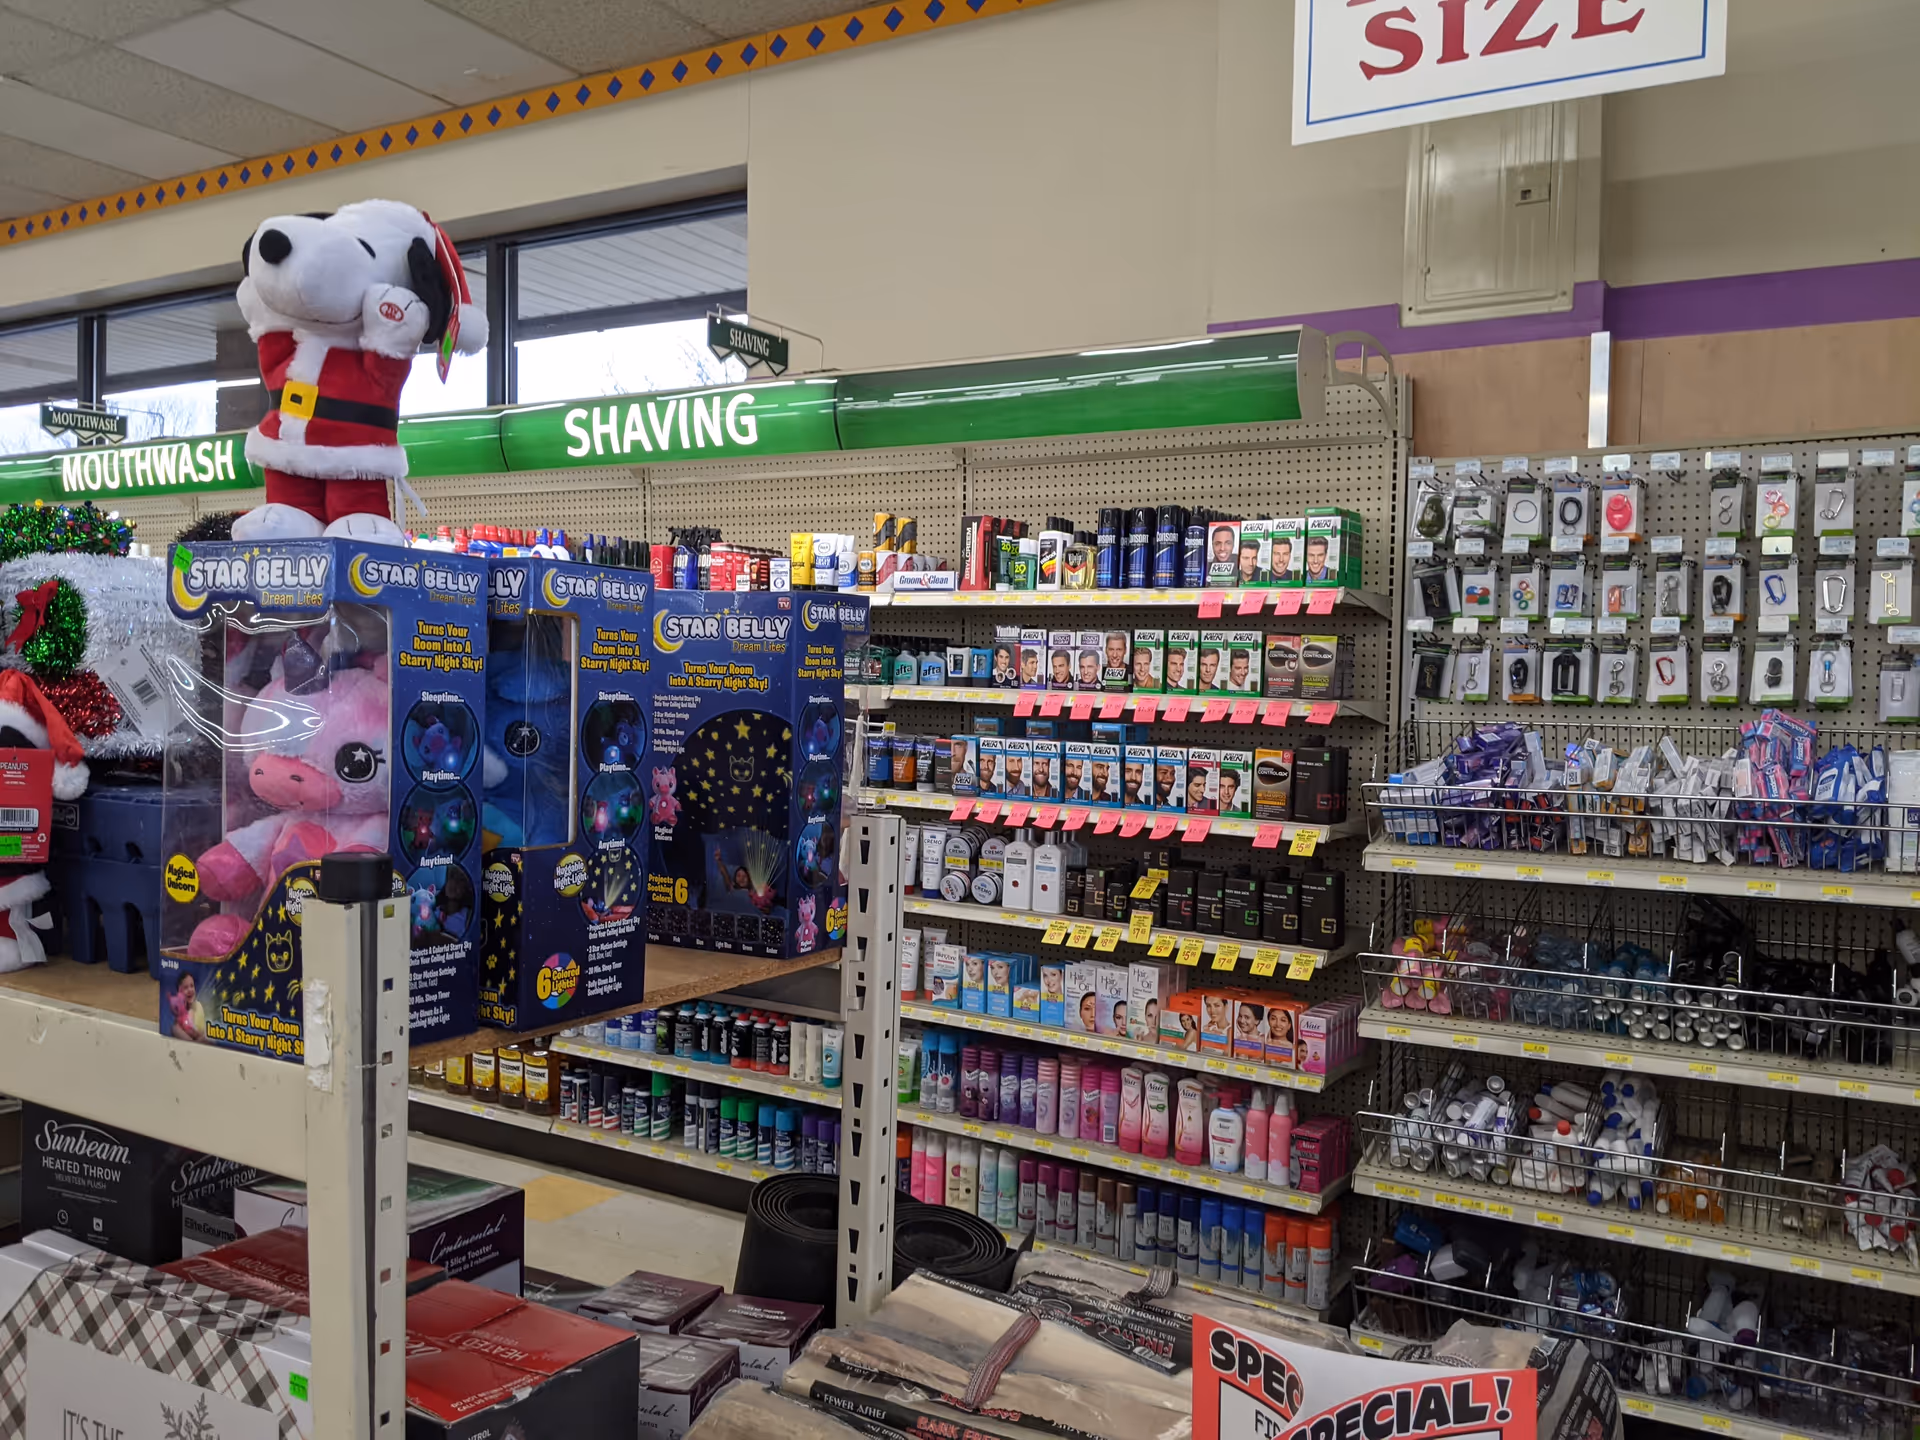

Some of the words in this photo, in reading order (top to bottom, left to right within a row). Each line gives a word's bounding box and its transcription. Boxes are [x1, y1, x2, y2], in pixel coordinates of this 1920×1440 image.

[1358, 0, 1645, 81] SIZE
[730, 327, 770, 357] SHAVING
[52, 410, 117, 432] MOUTHWASH
[564, 393, 758, 458] SHAVING
[62, 440, 236, 492] MOUTHWASH
[1156, 531, 1179, 543] CONSORT
[963, 527, 972, 580] BRYLCREEM
[189, 557, 249, 591] STAR
[253, 556, 329, 589] BELLY
[1014, 563, 1026, 574] 29
[365, 560, 418, 588] STAR
[423, 567, 480, 594] BELLY
[555, 575, 598, 598] STAR
[601, 581, 647, 602] BELLY
[261, 591, 294, 605] Dream
[297, 591, 323, 605] Lites
[495, 600, 520, 615] Lites
[809, 604, 836, 622] STAR
[839, 607, 866, 622] BELLY
[417, 621, 445, 636] Turns
[446, 623, 468, 638] Your
[597, 627, 618, 641] Turns
[620, 629, 638, 642] Your
[666, 616, 720, 639] STAR
[725, 616, 791, 640] BELLY
[413, 637, 441, 652] Room
[443, 638, 463, 653] Into
[465, 641, 471, 654] A
[593, 642, 615, 655] Room
[617, 645, 633, 656] Into
[634, 646, 640, 657] A
[732, 641, 761, 653] Dream
[763, 641, 786, 653] Lites
[807, 645, 822, 654] Turns
[822, 645, 835, 654] Your
[400, 652, 432, 670] Starry
[434, 655, 460, 673] Night
[461, 656, 483, 673] Sky!
[581, 656, 608, 673] Starry
[609, 659, 631, 673] Night
[632, 660, 650, 674] Sky!
[684, 662, 707, 674] Turns
[708, 662, 727, 675] Your
[729, 663, 753, 675] Room
[805, 656, 821, 666] Room
[820, 657, 832, 666] Into
[798, 668, 816, 680] Starry
[816, 668, 830, 681] Night
[831, 669, 842, 680] Sky!
[896, 664, 912, 676] afta
[922, 664, 942, 677] afta
[669, 675, 686, 686] Into
[688, 676, 694, 687] A
[695, 676, 722, 689] Starry
[723, 677, 747, 690] Night
[748, 678, 768, 690] Sky!
[421, 691, 465, 704] Sleeptime...
[422, 769, 461, 783] Playtime...
[598, 837, 626, 851] Anytime!
[923, 838, 943, 846] CREMO
[948, 848, 967, 856] CREMO
[984, 848, 1003, 857] CREMO
[420, 854, 454, 868] Anytime!
[556, 860, 585, 876] Huggable
[168, 864, 195, 881] Magical
[553, 871, 589, 890] Night-Light
[648, 873, 674, 884] Projects
[167, 877, 196, 893] Unicorn
[674, 877, 688, 905] 6
[973, 884, 993, 896] CREMO
[826, 907, 834, 933] 6
[536, 967, 551, 1000] 6
[551, 965, 580, 982] Colored
[1069, 971, 1083, 985] Hair
[1101, 975, 1115, 990] Hair
[1133, 968, 1147, 983] Hair
[551, 977, 577, 993] Lights!
[222, 1007, 247, 1025] Turns
[249, 1012, 270, 1030] Your
[272, 1016, 299, 1036] Room
[493, 1005, 515, 1025] Sky!
[1303, 1021, 1321, 1030] Nair
[207, 1022, 226, 1039] Into
[227, 1026, 233, 1041] A
[235, 1028, 265, 1051] Starry
[267, 1034, 292, 1056] Night
[1124, 1077, 1137, 1086] Nair
[1148, 1082, 1165, 1092] Nair
[1179, 1088, 1197, 1098] Nair
[35, 1119, 132, 1165] Sunbeam
[1301, 1141, 1316, 1150] Nair
[42, 1156, 80, 1174] HEATED
[83, 1164, 121, 1182] THROW
[86, 1179, 107, 1190] PLUSH
[218, 1168, 257, 1193] THROW
[430, 1214, 505, 1265] Continental
[450, 1256, 467, 1268] Slice
[467, 1244, 493, 1260] Toaster
[463, 1338, 529, 1361] HEATED
[824, 1393, 854, 1411] FEWER
[856, 1403, 887, 1421] ASHES
[916, 1415, 958, 1440] BARK
